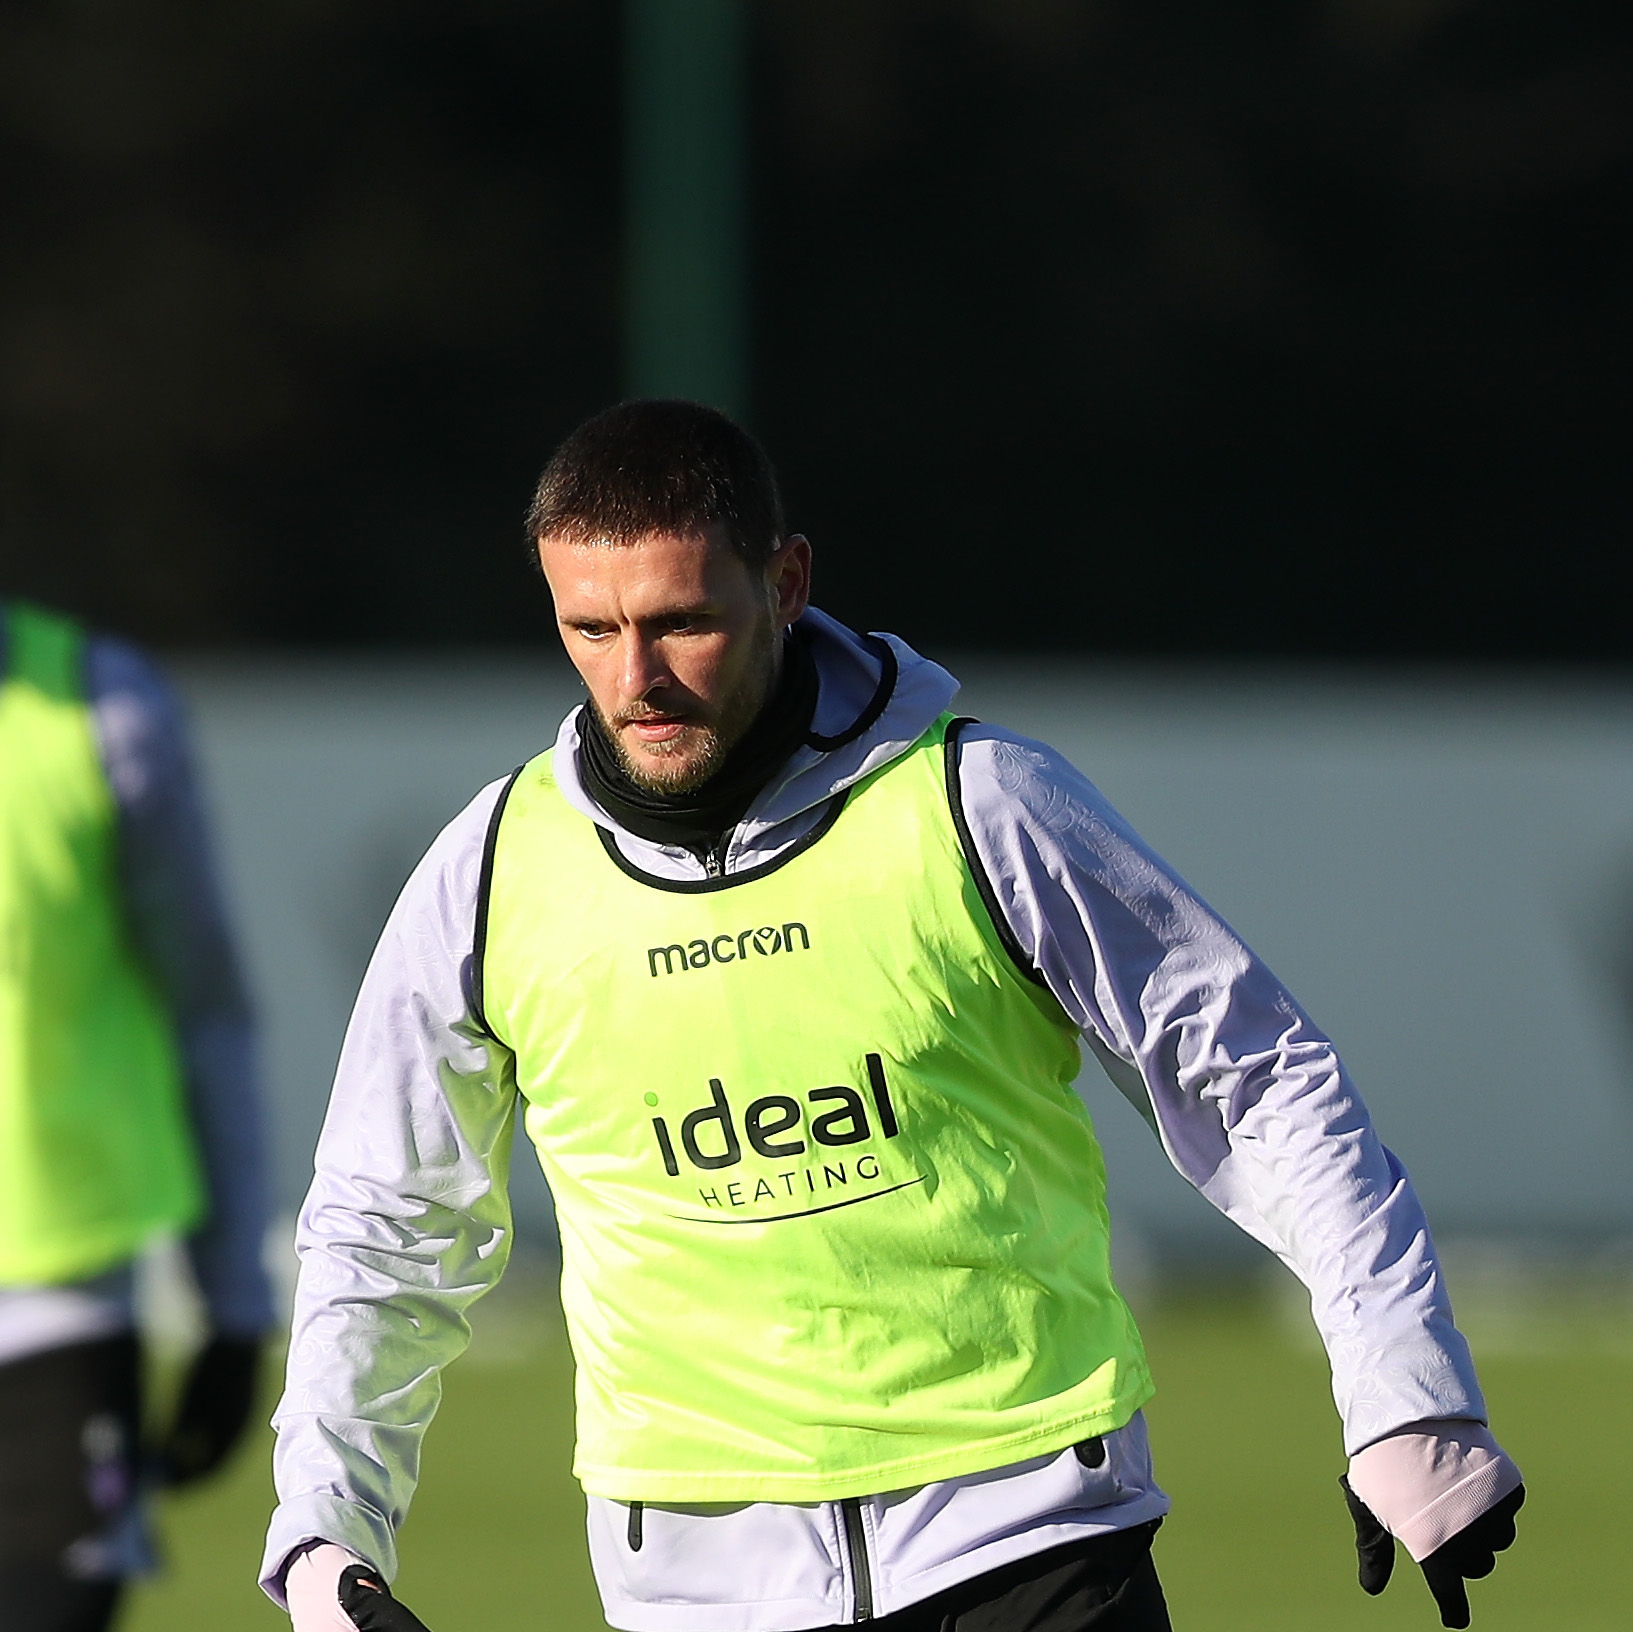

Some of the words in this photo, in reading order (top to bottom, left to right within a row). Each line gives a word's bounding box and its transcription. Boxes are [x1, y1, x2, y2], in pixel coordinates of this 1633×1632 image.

[647, 922, 810, 977] macron
[644, 1052, 899, 1177] ideal
[698, 1155, 880, 1208] HEATING
